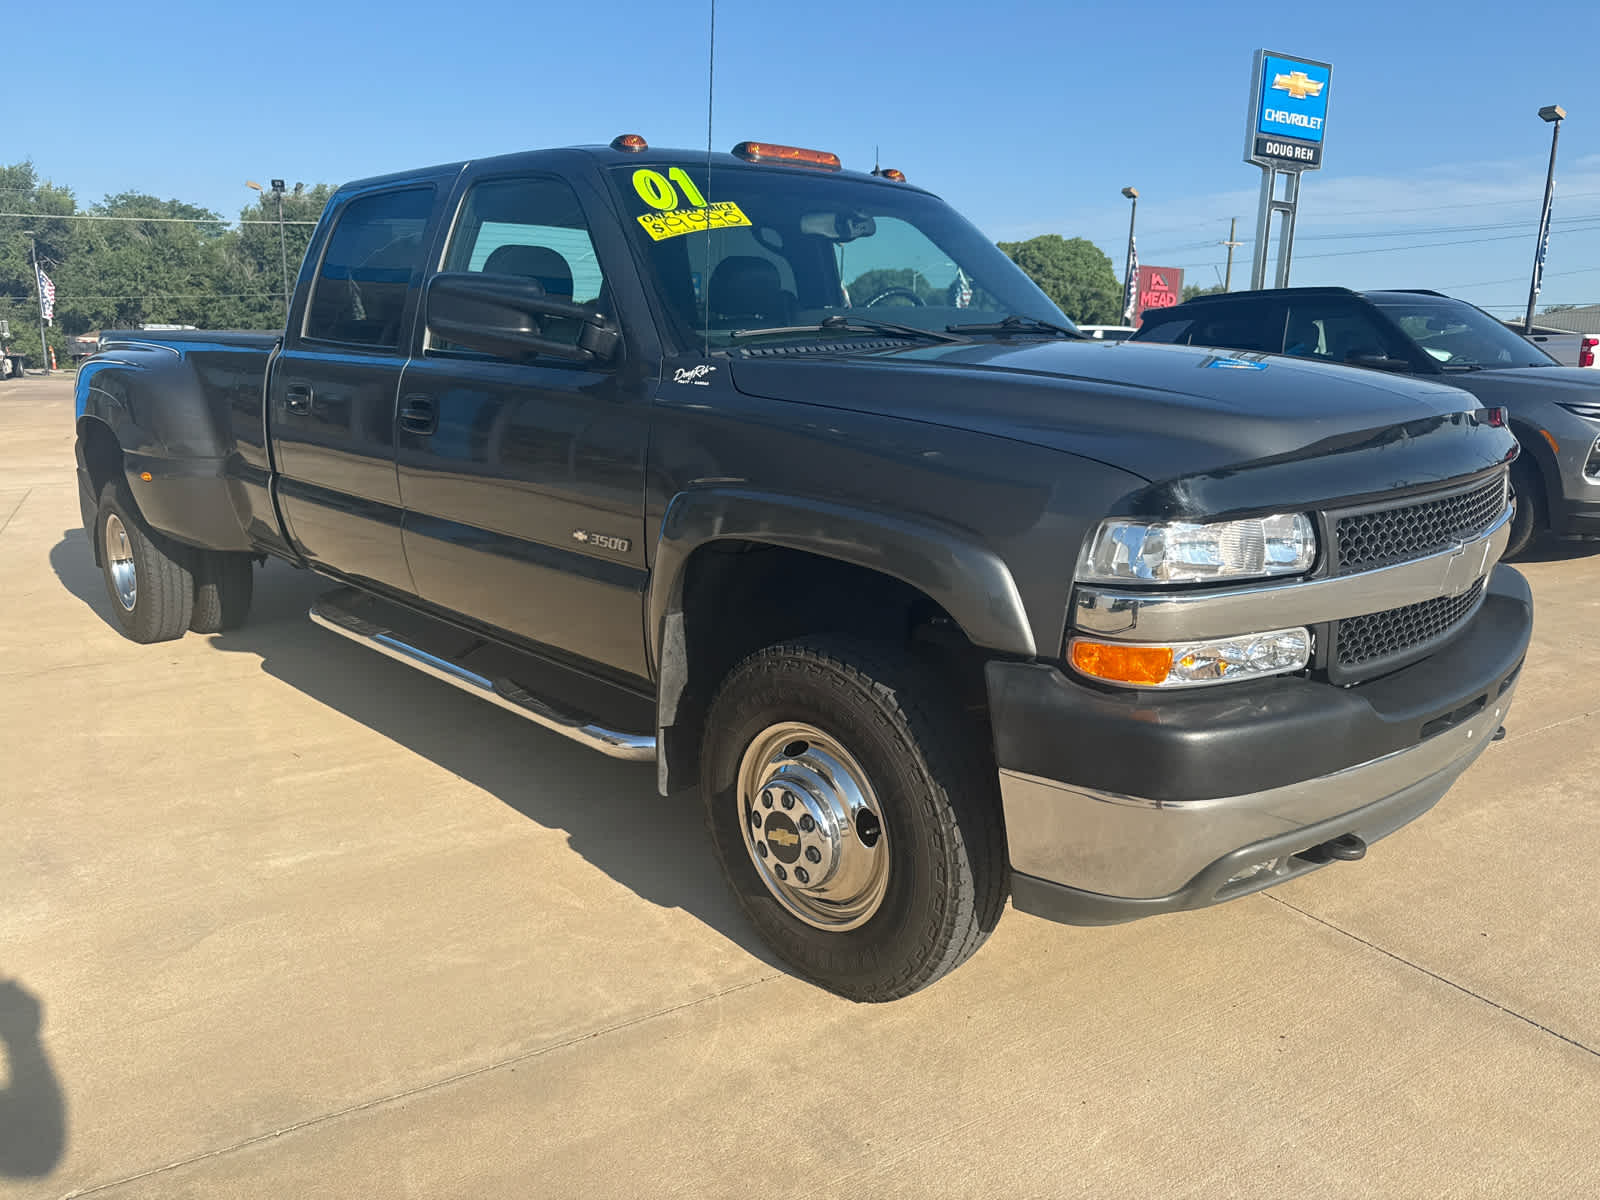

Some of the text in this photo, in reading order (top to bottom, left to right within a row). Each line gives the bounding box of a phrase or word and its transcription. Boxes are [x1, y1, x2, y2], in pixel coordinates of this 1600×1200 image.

[1265, 109, 1323, 129] CHEVROLET
[1266, 142, 1314, 160] DOUG REH
[632, 167, 708, 211] 01
[1141, 291, 1176, 307] MEAD
[591, 533, 629, 552] 3500
